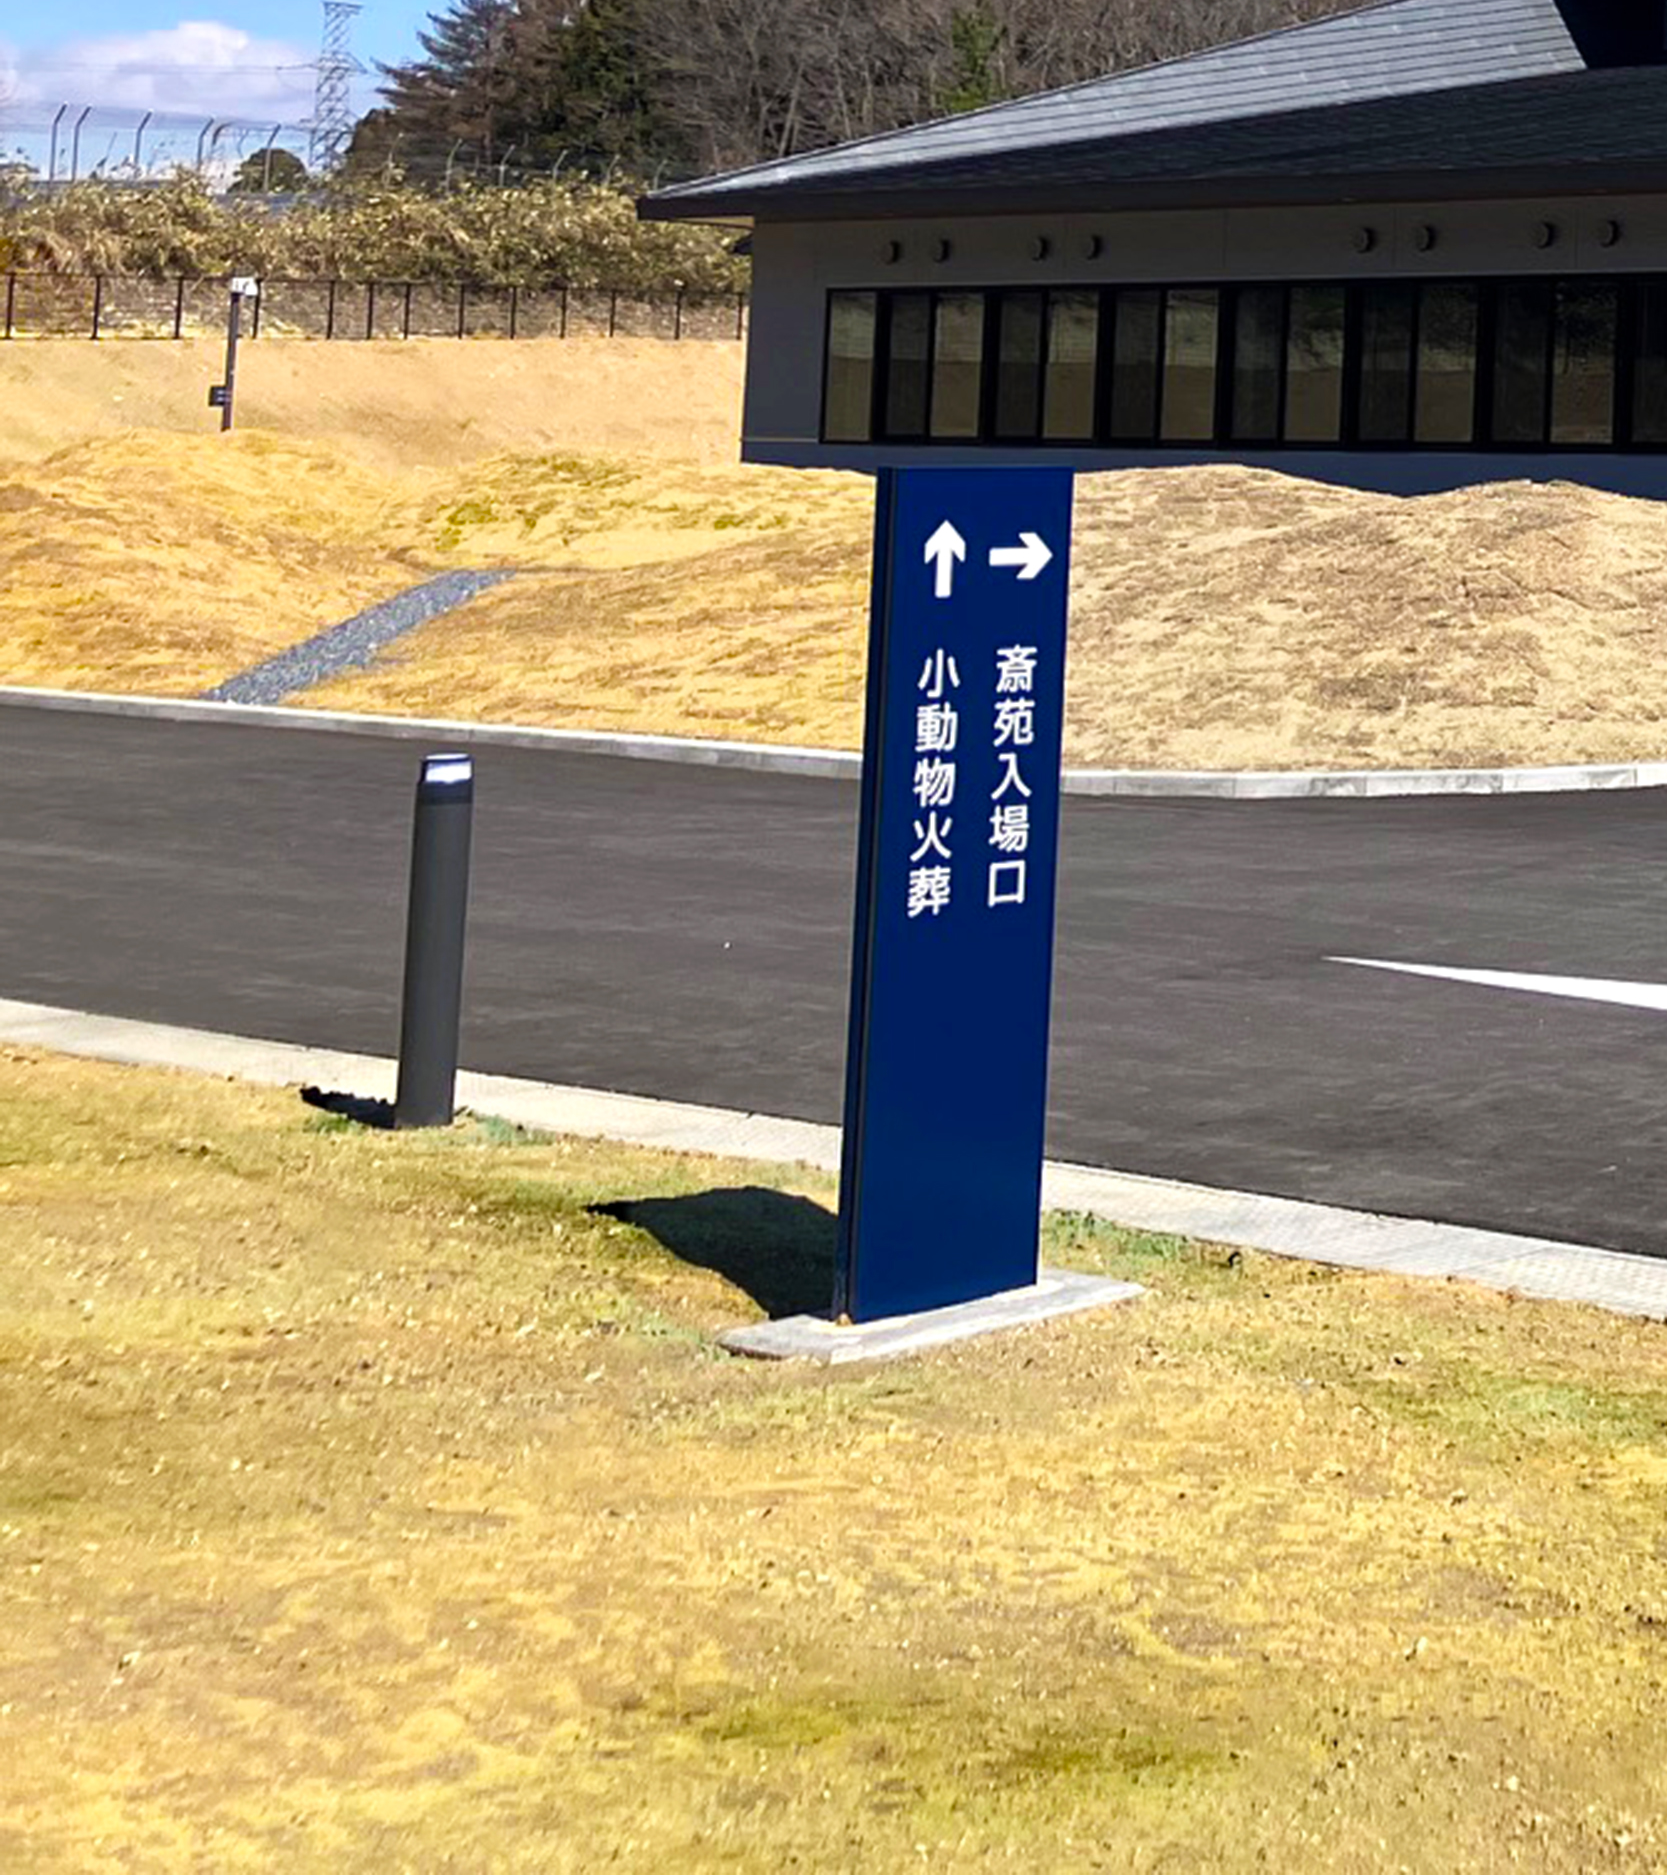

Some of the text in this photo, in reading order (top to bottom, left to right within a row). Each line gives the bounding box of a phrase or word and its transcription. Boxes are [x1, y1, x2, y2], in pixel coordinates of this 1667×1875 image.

[907, 648, 960, 918] 小動物火葬
[988, 644, 1038, 907] 斎苑入場口
